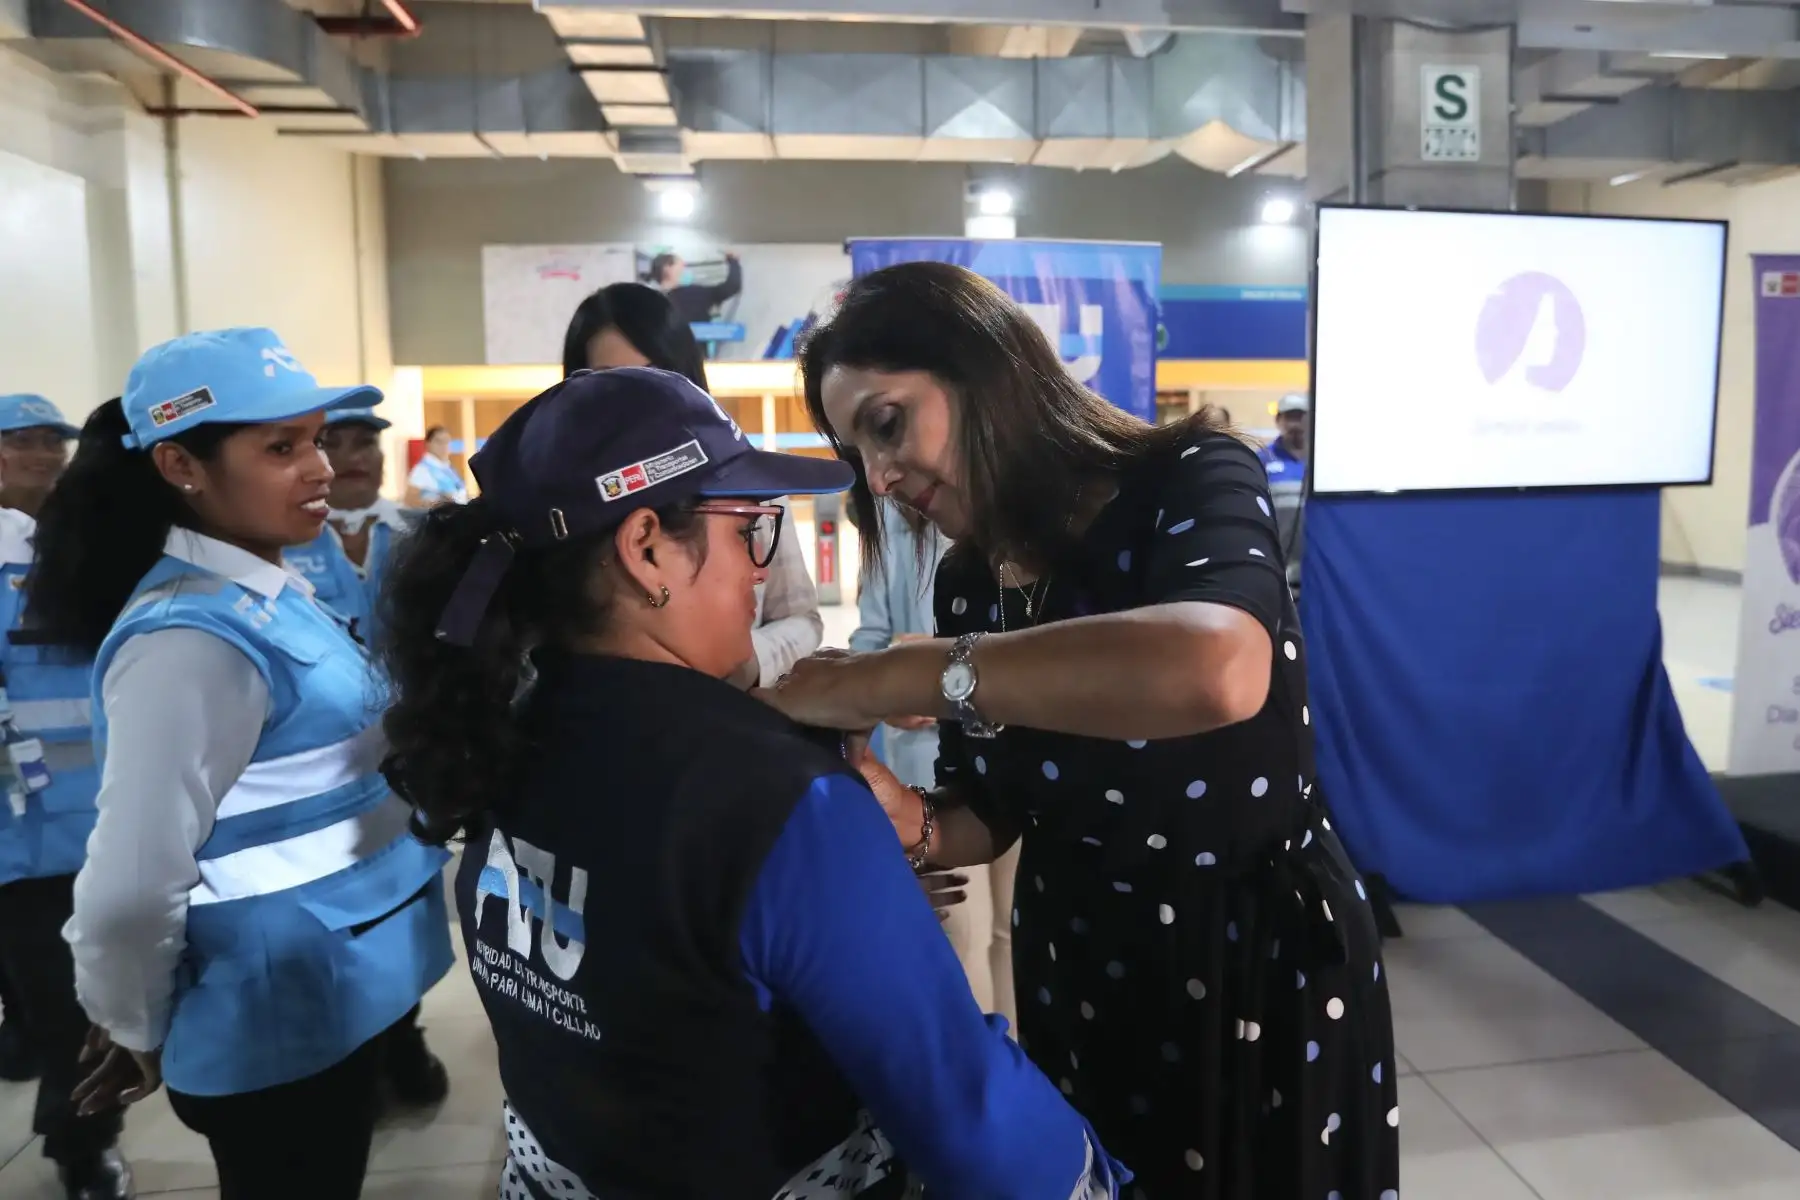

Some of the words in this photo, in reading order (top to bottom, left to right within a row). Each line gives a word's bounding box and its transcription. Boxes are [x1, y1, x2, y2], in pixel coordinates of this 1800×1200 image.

[1434, 74, 1467, 121] S
[475, 828, 588, 981] ATU
[490, 972, 518, 999] PARA
[521, 986, 543, 1015] LIMA
[552, 1007, 601, 1040] CALLAO
